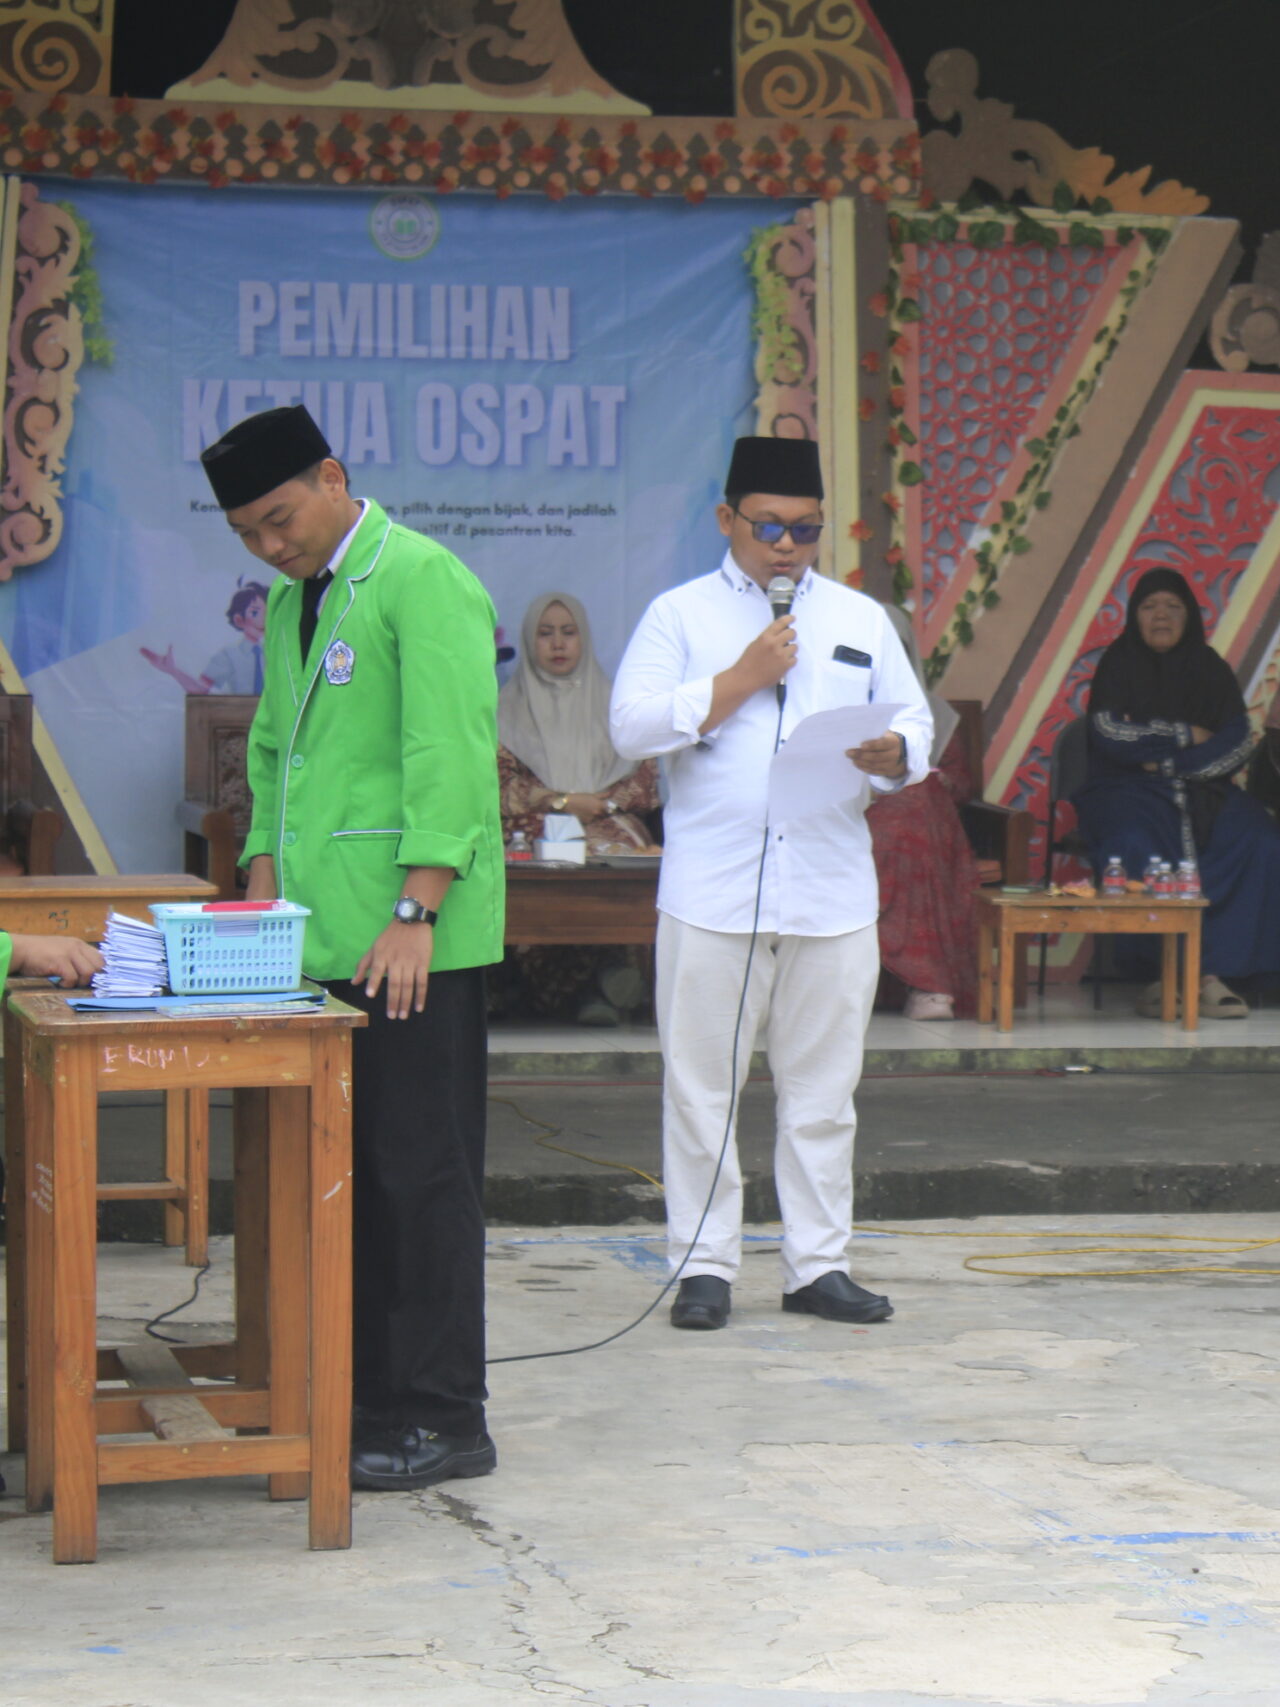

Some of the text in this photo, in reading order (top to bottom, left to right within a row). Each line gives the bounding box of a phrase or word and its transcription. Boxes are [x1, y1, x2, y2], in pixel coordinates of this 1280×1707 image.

[238, 281, 570, 360] PEMILIHAN
[416, 381, 627, 467] OSPAT
[402, 503, 433, 517] pilih
[436, 503, 490, 517] dengan
[494, 504, 532, 517] bijak,
[537, 504, 565, 517] dan
[567, 504, 617, 519] jadilah
[453, 525, 467, 536] di
[470, 526, 542, 539] pesantren
[546, 525, 576, 537] kita.
